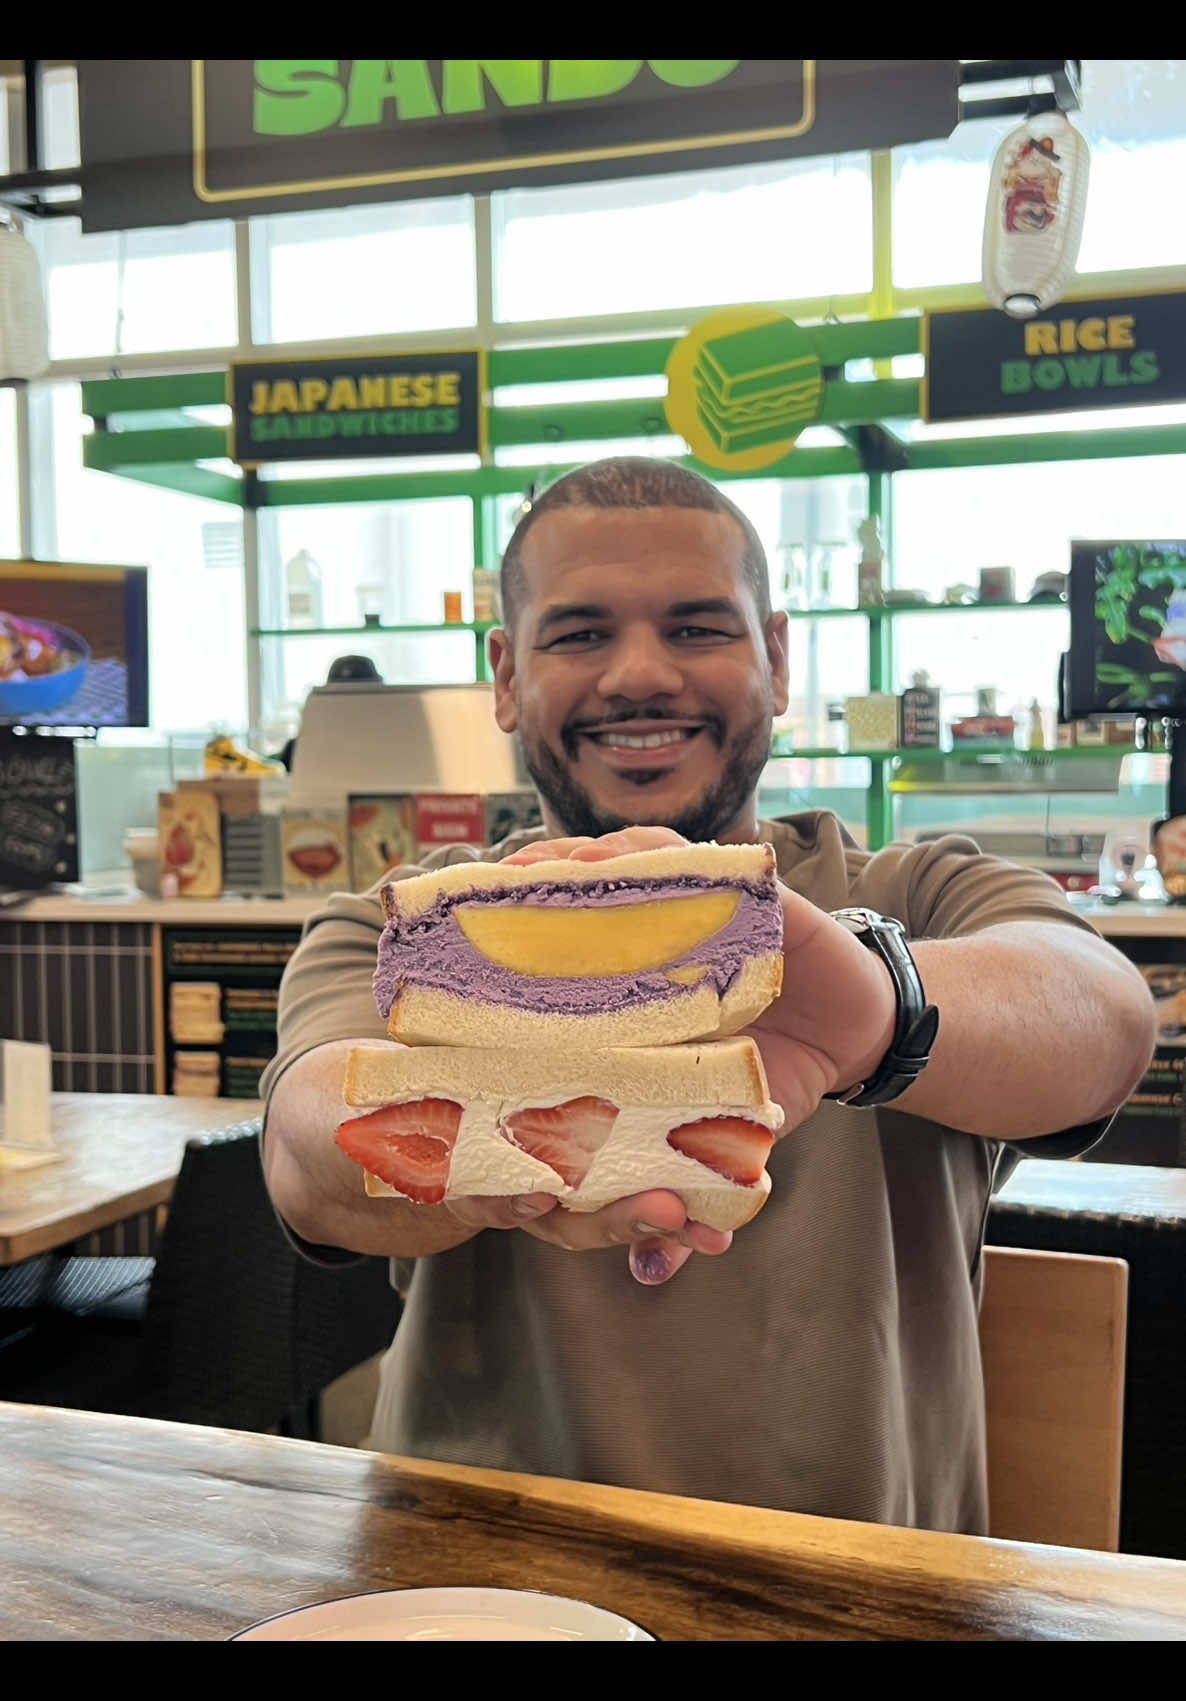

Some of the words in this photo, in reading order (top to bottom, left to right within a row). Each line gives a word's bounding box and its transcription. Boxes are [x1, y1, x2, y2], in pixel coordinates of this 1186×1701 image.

[253, 60, 738, 136] SAN
[1025, 315, 1135, 356] RICE
[249, 372, 460, 415] JAPANESE
[1001, 351, 1160, 394] BOWLS
[251, 408, 459, 441] SANDWICHES
